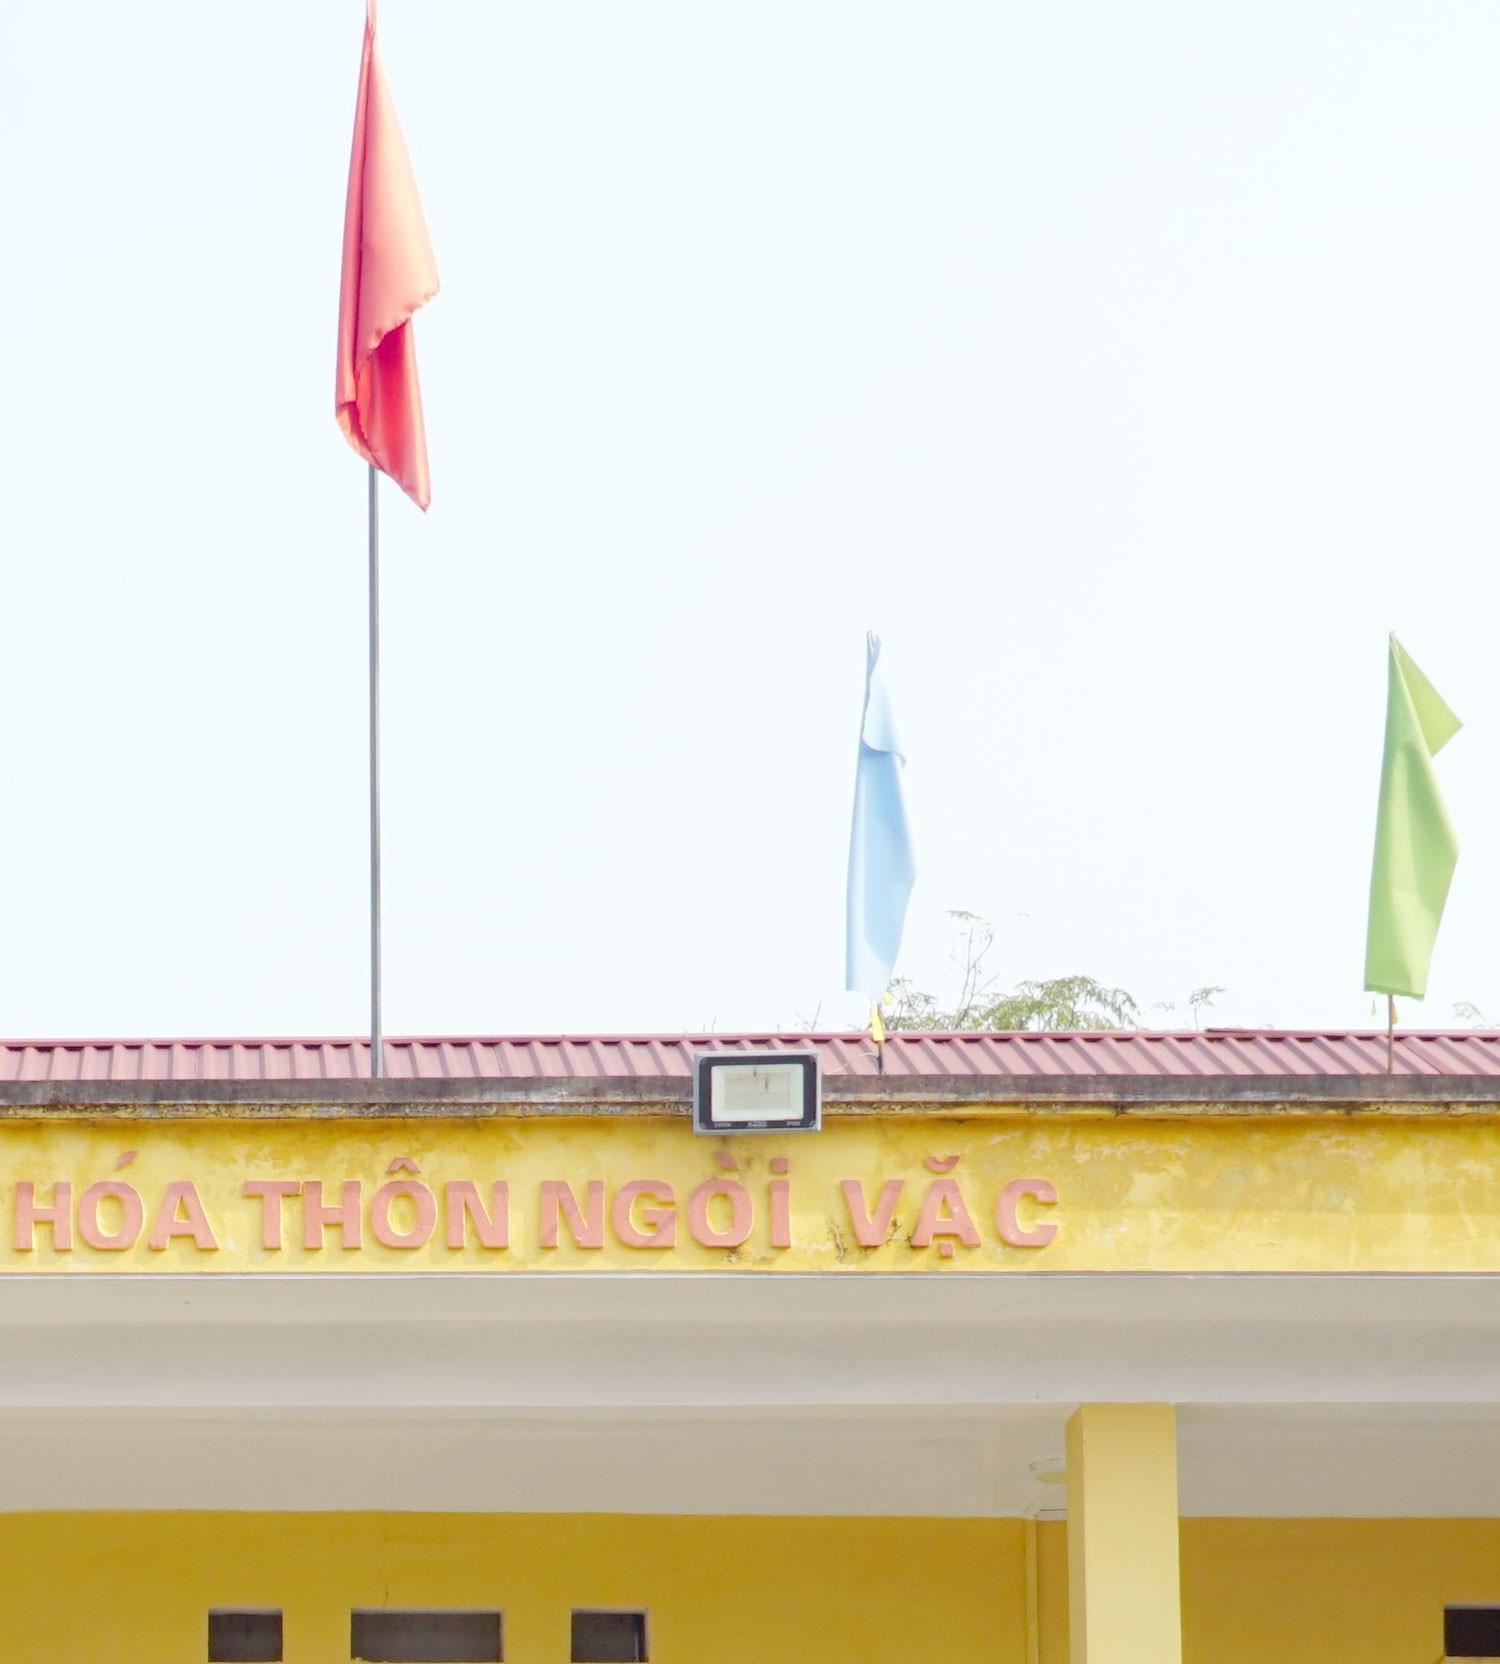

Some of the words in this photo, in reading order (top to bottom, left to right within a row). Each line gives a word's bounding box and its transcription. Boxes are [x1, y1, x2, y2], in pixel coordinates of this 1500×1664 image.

[13, 1150, 219, 1251] HÓA
[242, 1156, 510, 1250] THÔN
[840, 1155, 1059, 1258] VẶC
